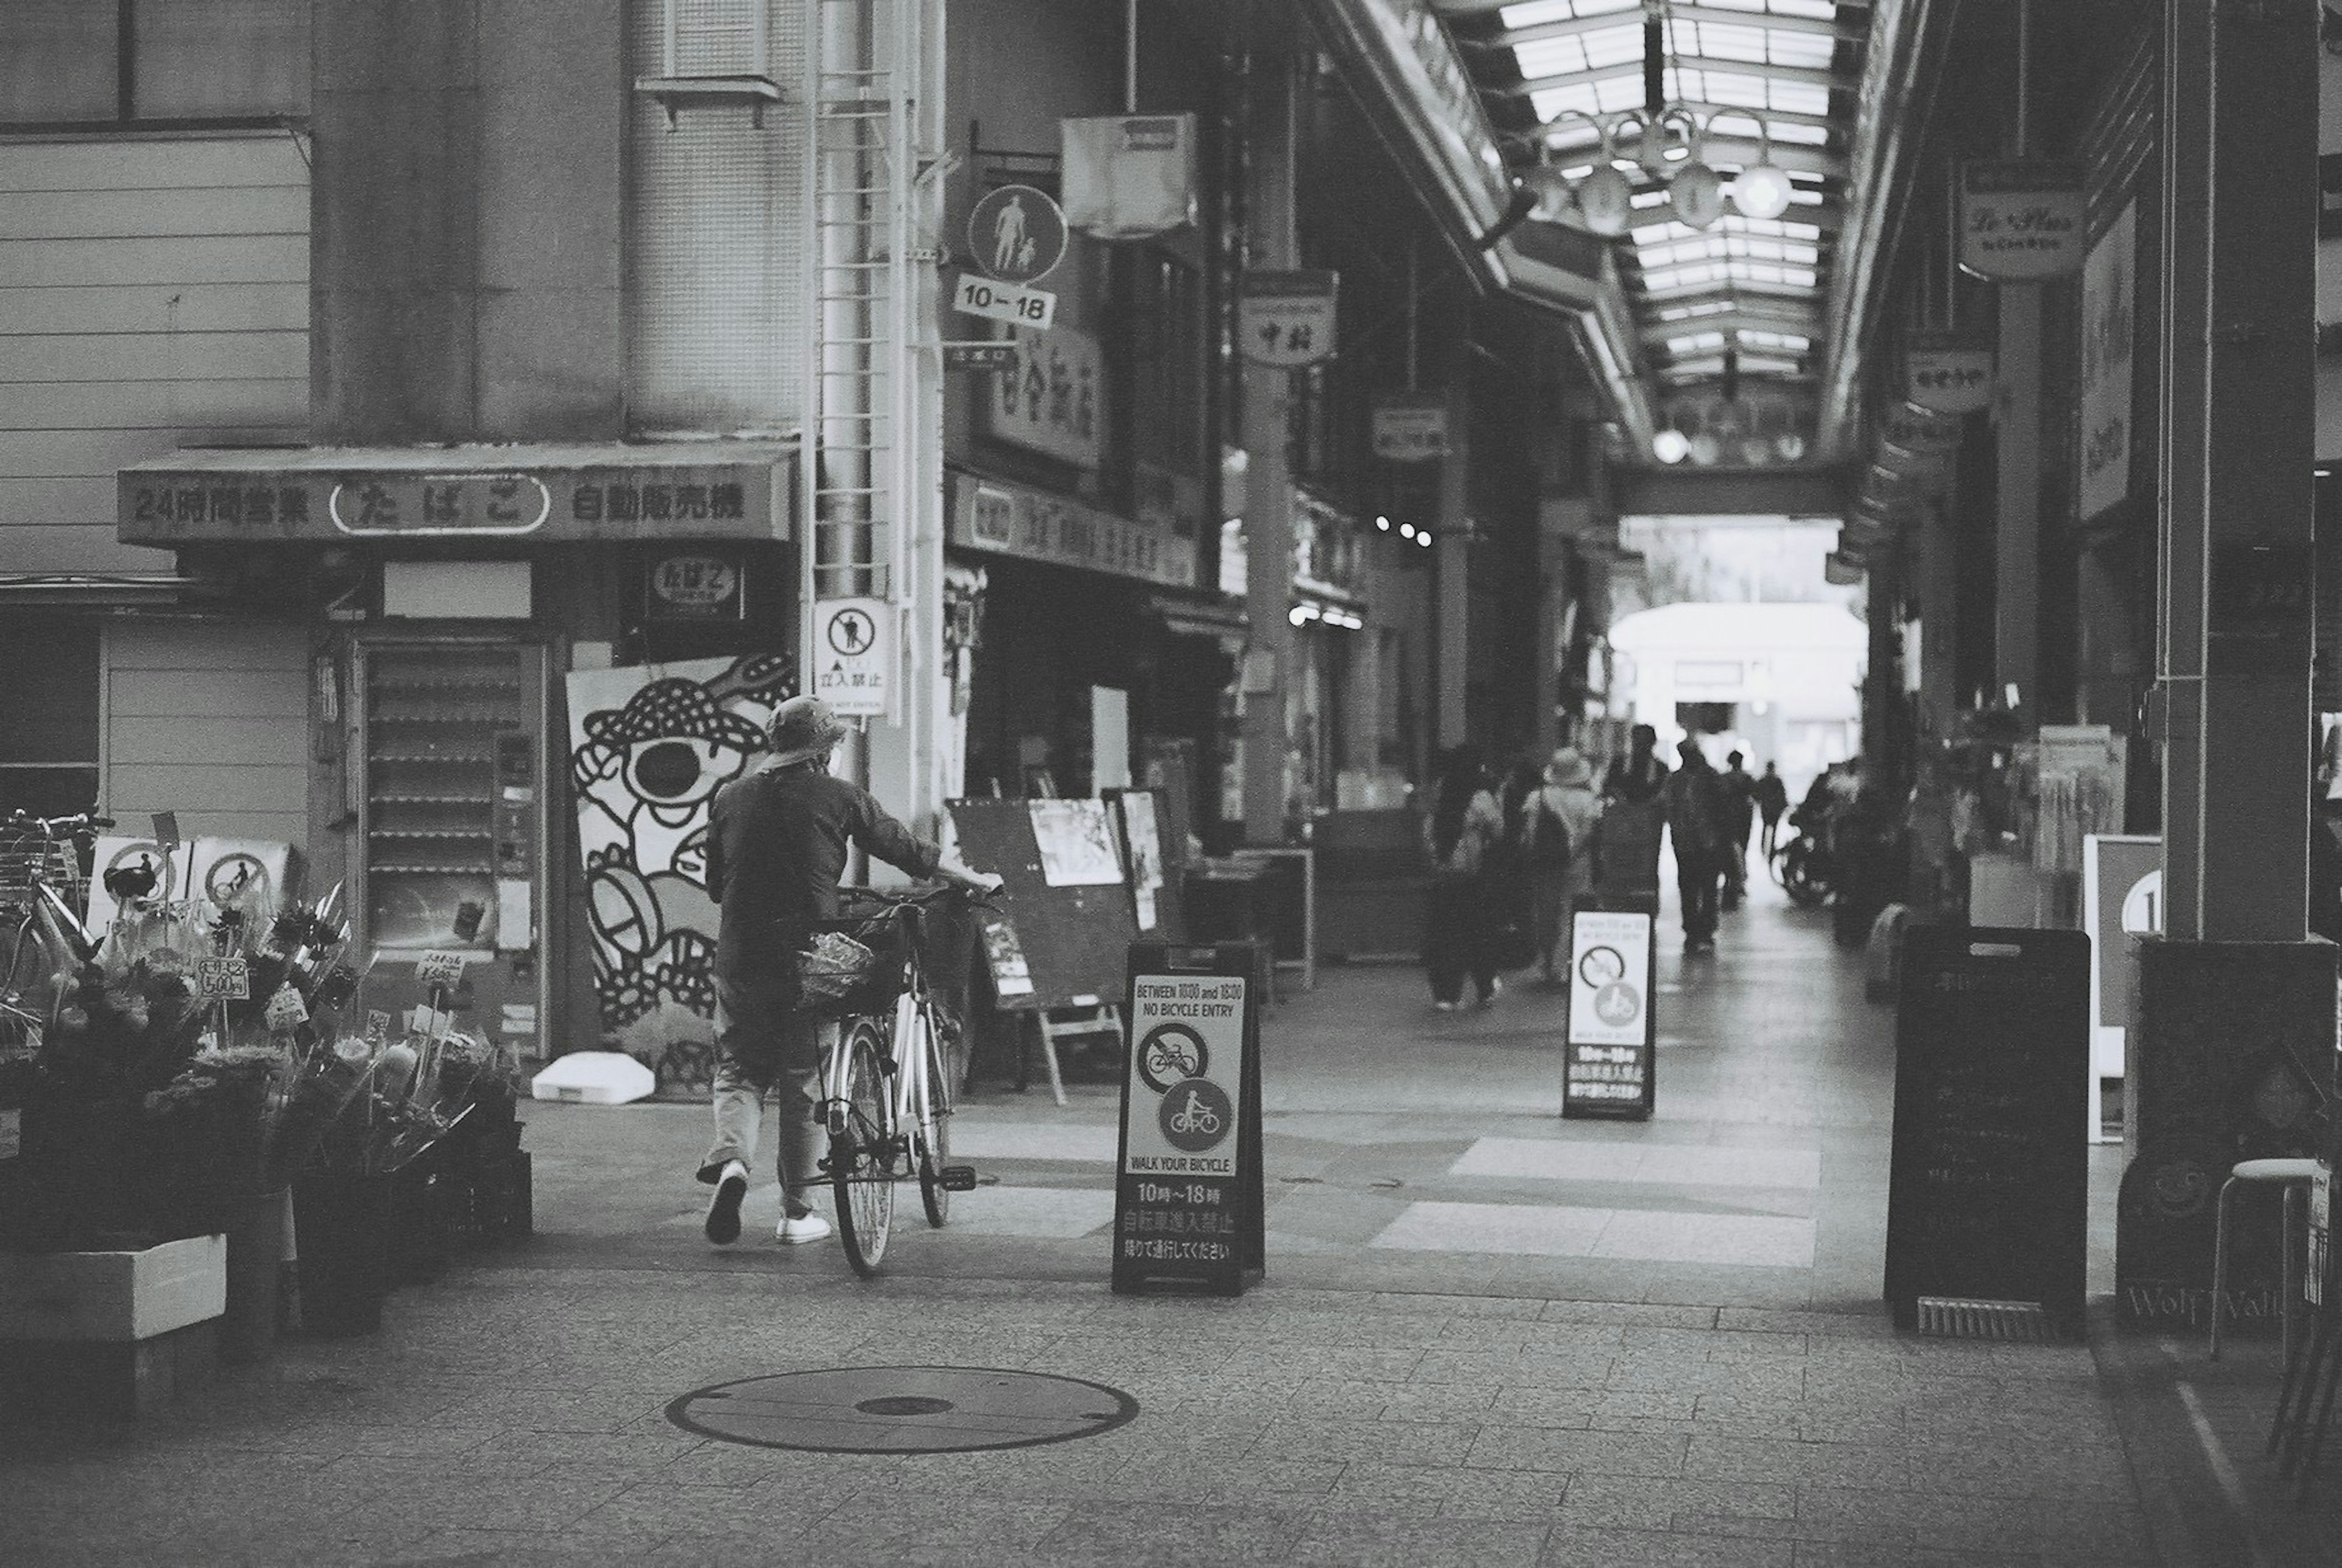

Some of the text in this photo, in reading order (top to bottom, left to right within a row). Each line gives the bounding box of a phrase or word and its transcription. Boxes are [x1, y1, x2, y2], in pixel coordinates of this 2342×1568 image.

[135, 481, 745, 525] 24時間営業 たばこ 自動販売機
[820, 673, 883, 687] 立入禁止
[1137, 984, 1176, 998] BETWEEN
[1201, 986, 1218, 1000] and
[1142, 1003, 1234, 1018] NO BICYCLE ENTRY
[1131, 1158, 1231, 1173] WALK YOUR BICYCLE
[1125, 1239, 1230, 1259] 降りて通行してください
